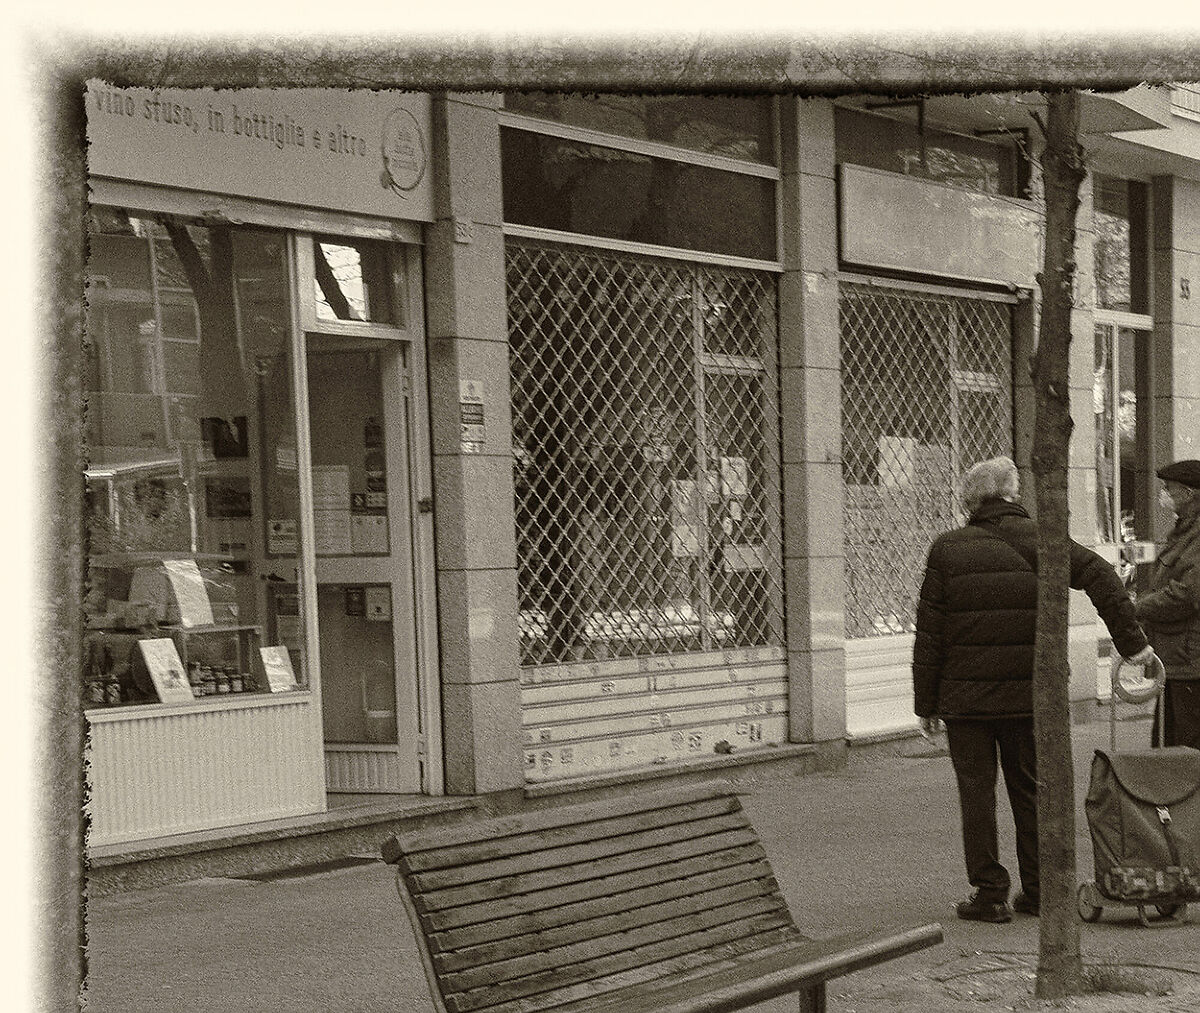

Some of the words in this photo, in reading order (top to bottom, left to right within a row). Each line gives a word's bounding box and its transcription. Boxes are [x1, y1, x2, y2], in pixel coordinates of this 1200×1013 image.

[207, 104, 225, 133] in
[232, 104, 306, 151] bottiglia
[312, 129, 322, 149] e
[328, 123, 367, 157] altro
